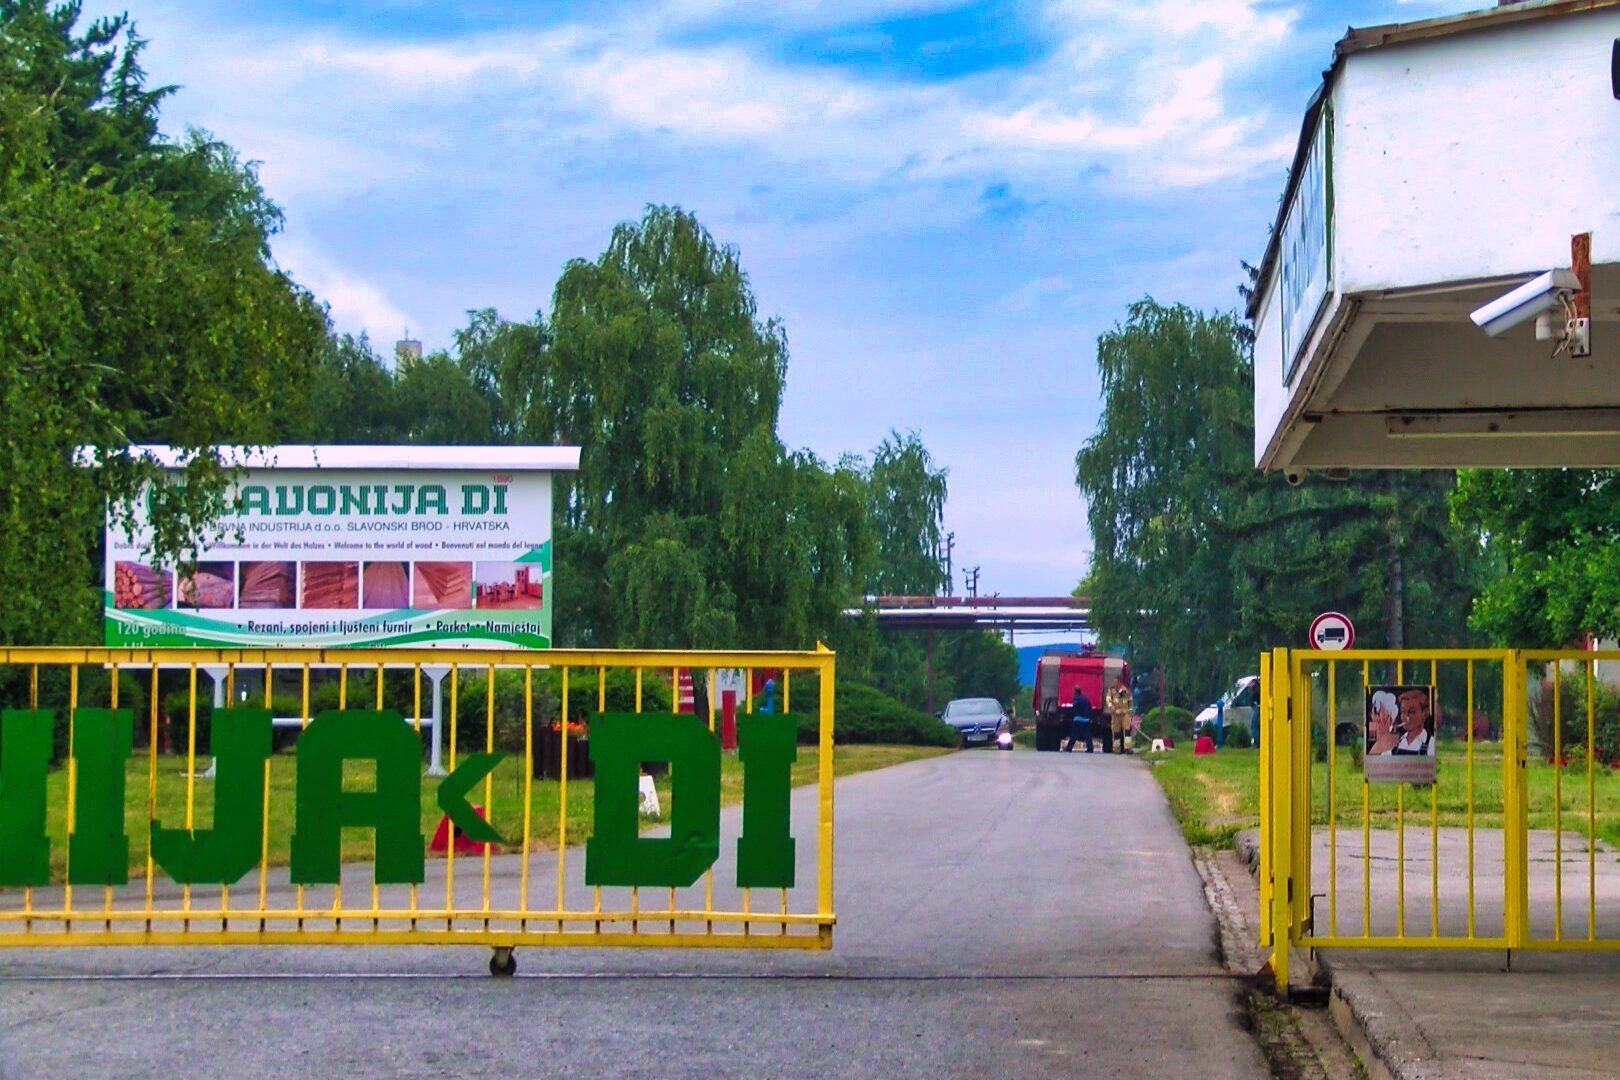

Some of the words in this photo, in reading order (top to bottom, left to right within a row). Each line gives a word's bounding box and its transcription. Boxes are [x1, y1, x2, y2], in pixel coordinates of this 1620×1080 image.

[212, 485, 449, 515] LAVONIJA
[462, 485, 508, 515] DI
[249, 522, 312, 532] INDUSTRIJA
[347, 521, 408, 532] SLAVONSKI
[411, 521, 443, 531] BROD
[453, 521, 510, 531] HRVATSKA
[334, 541, 364, 550] Welcome
[373, 540, 385, 550] the
[386, 541, 405, 550] world
[441, 540, 474, 550] Benvenuti
[117, 622, 139, 635] 120
[143, 622, 186, 638] godina
[247, 620, 287, 634] Rezani,
[290, 620, 329, 634] spojeni
[332, 620, 336, 632] i
[339, 620, 379, 635] ljušteni
[383, 620, 413, 633] furnir
[436, 620, 470, 633] Parket
[486, 620, 540, 636] Namještaj
[584, 711, 798, 888] DI
